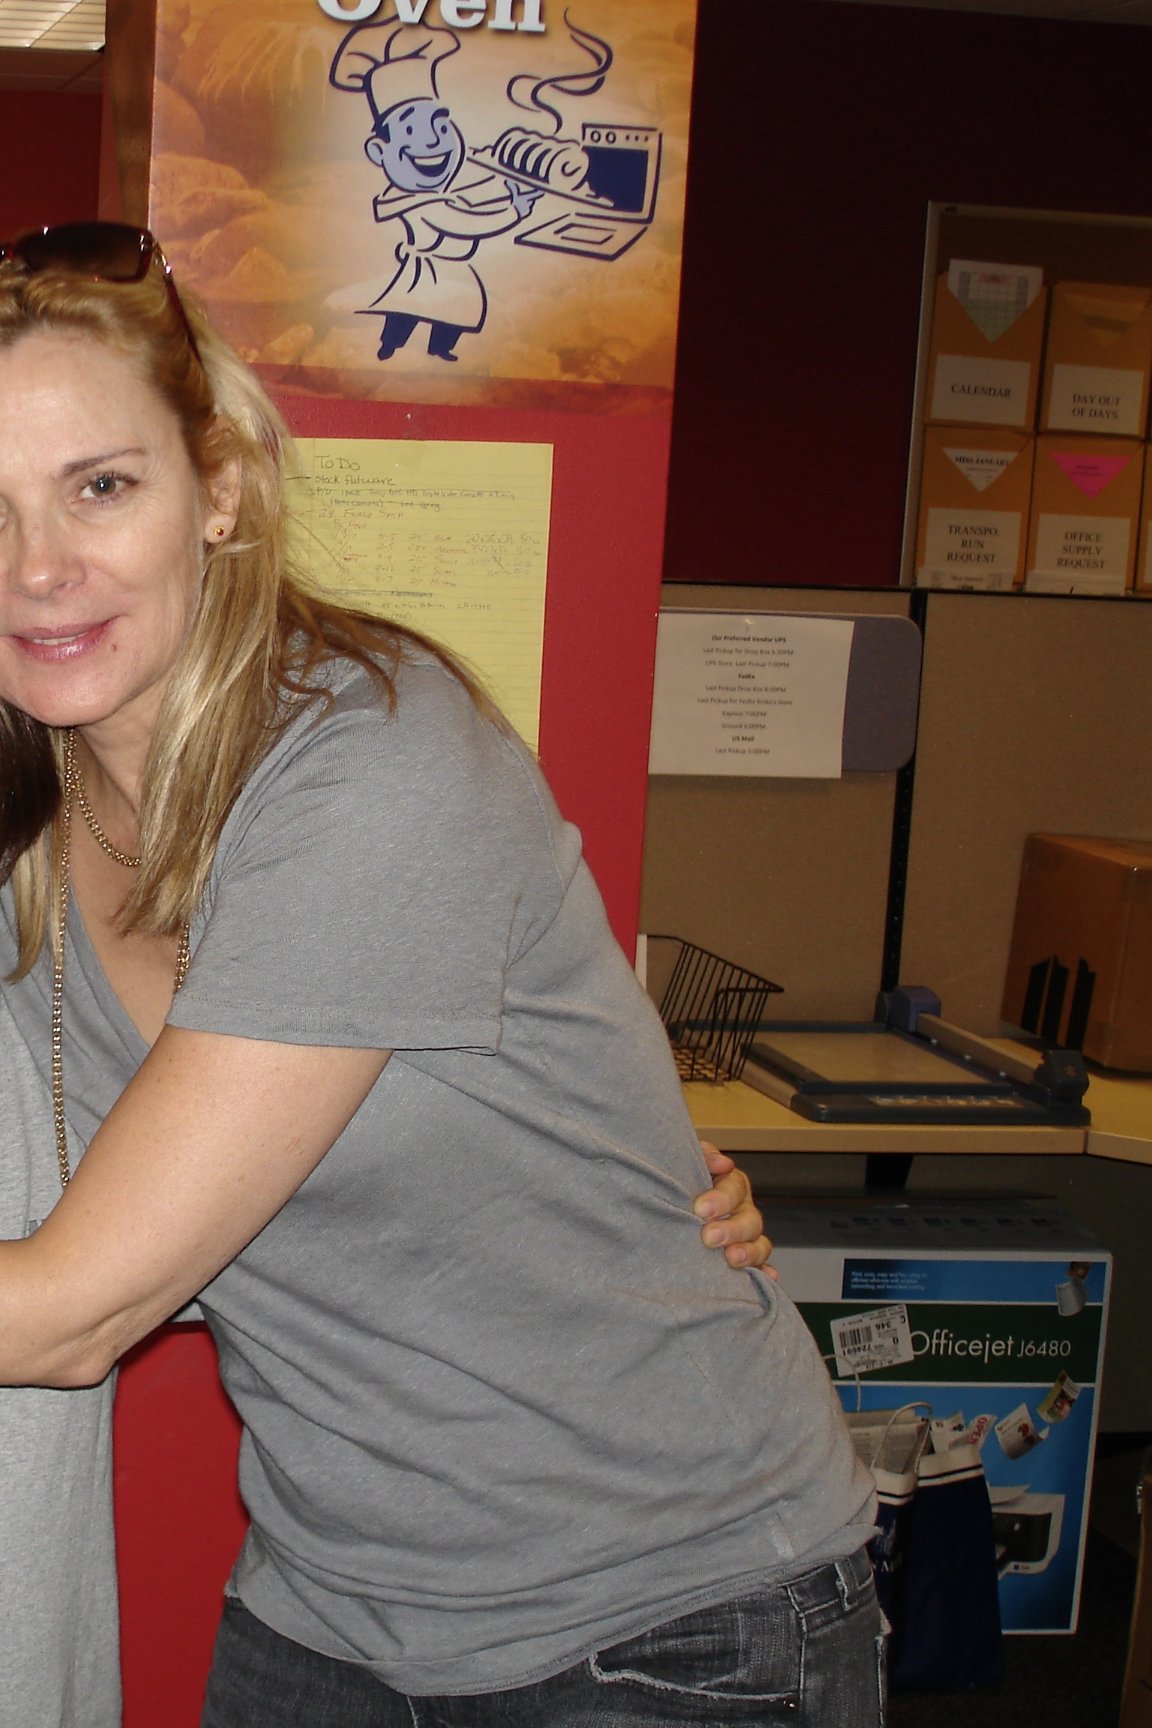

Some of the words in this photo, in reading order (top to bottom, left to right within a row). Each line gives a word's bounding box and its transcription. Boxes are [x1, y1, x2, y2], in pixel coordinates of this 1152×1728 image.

[951, 384, 1011, 398] CALENDAR
[1072, 393, 1096, 404] DAY
[1098, 395, 1120, 406] OUT
[1072, 407, 1085, 417] OF
[1089, 408, 1118, 419] DAYS
[315, 455, 334, 469] To
[336, 457, 360, 471] Do
[955, 455, 974, 464] MISS
[1064, 531, 1103, 543] OFFICE
[961, 538, 984, 549] RUN
[1062, 544, 1103, 556] SUPPLY
[946, 551, 996, 564] REQUEST
[1056, 557, 1105, 570] REQUEST
[711, 634, 722, 642] Our
[723, 634, 751, 643] Preferred
[752, 635, 773, 643] Vendor
[910, 1328, 1015, 1364] Officejet
[1017, 1339, 1072, 1358] J6480
